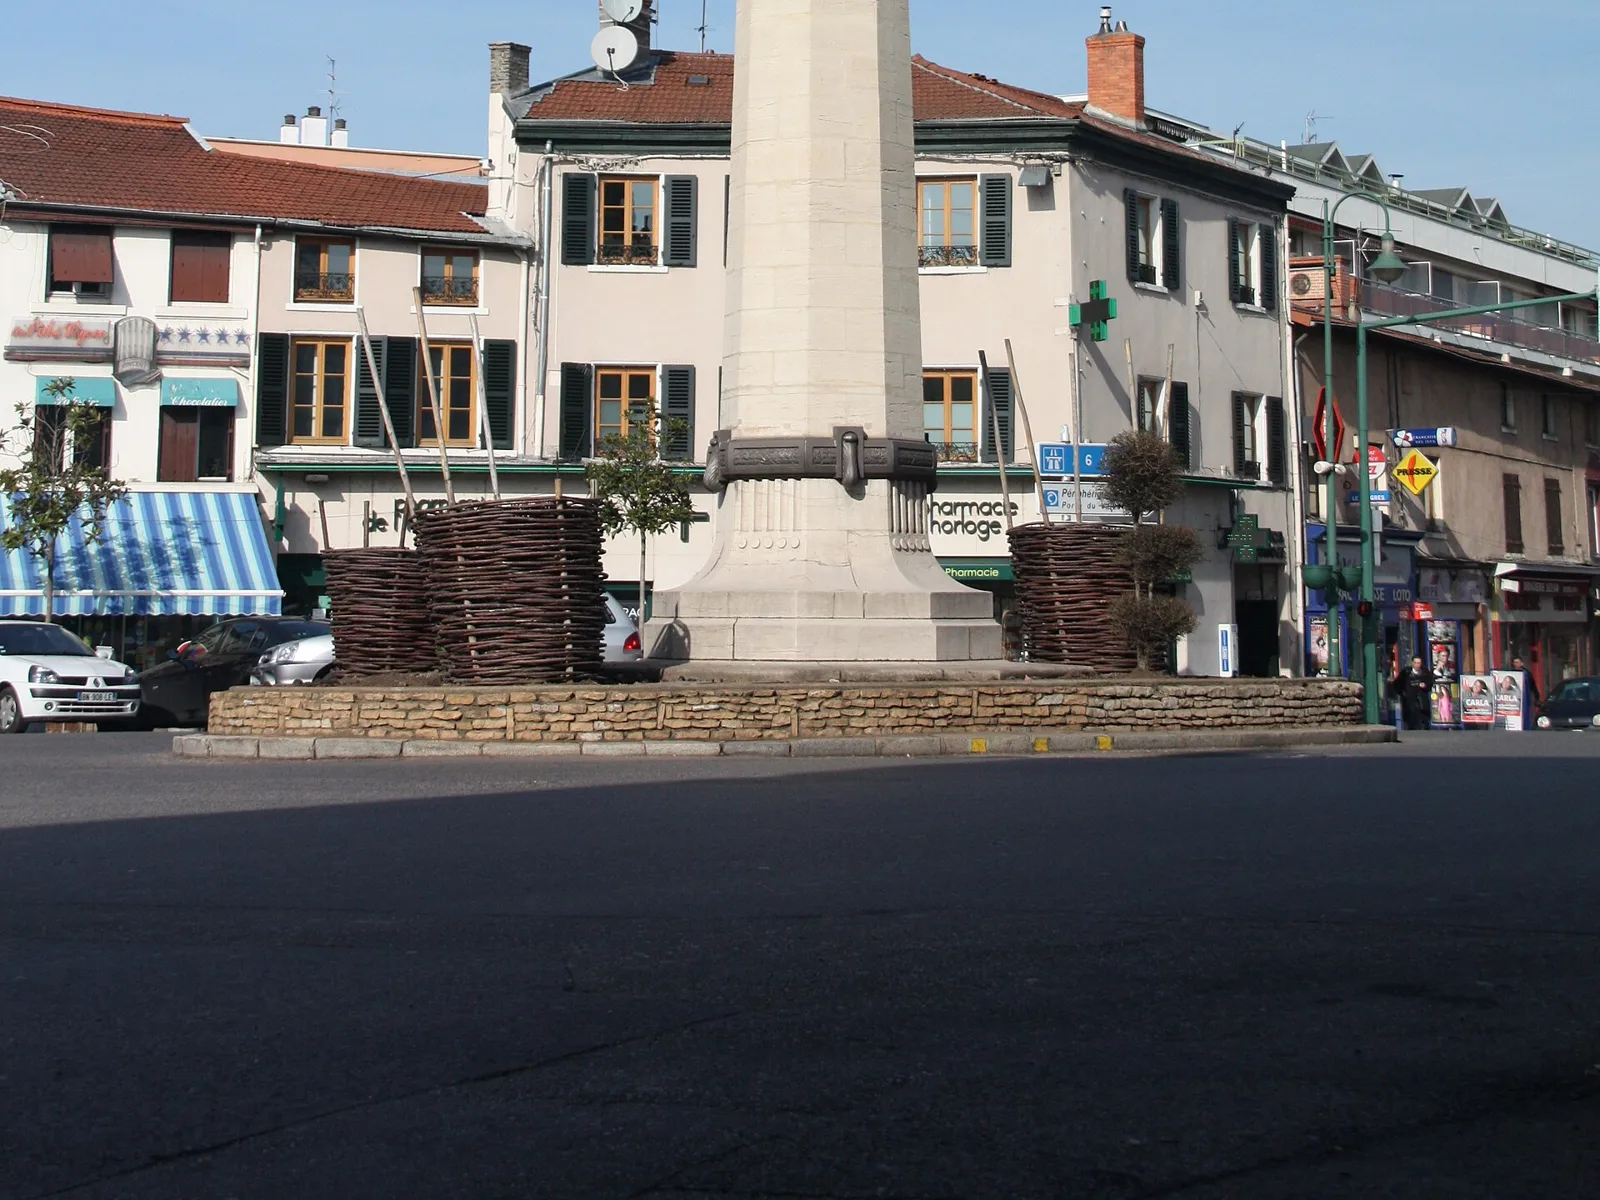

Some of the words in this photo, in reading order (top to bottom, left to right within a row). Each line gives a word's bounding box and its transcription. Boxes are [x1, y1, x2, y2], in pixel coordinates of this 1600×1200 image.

[1396, 467, 1433, 476] PRESSE
[1087, 502, 1096, 510] du
[945, 567, 1000, 578] Pharmacie
[1392, 589, 1411, 602] LOTO
[1465, 699, 1490, 707] CARLA
